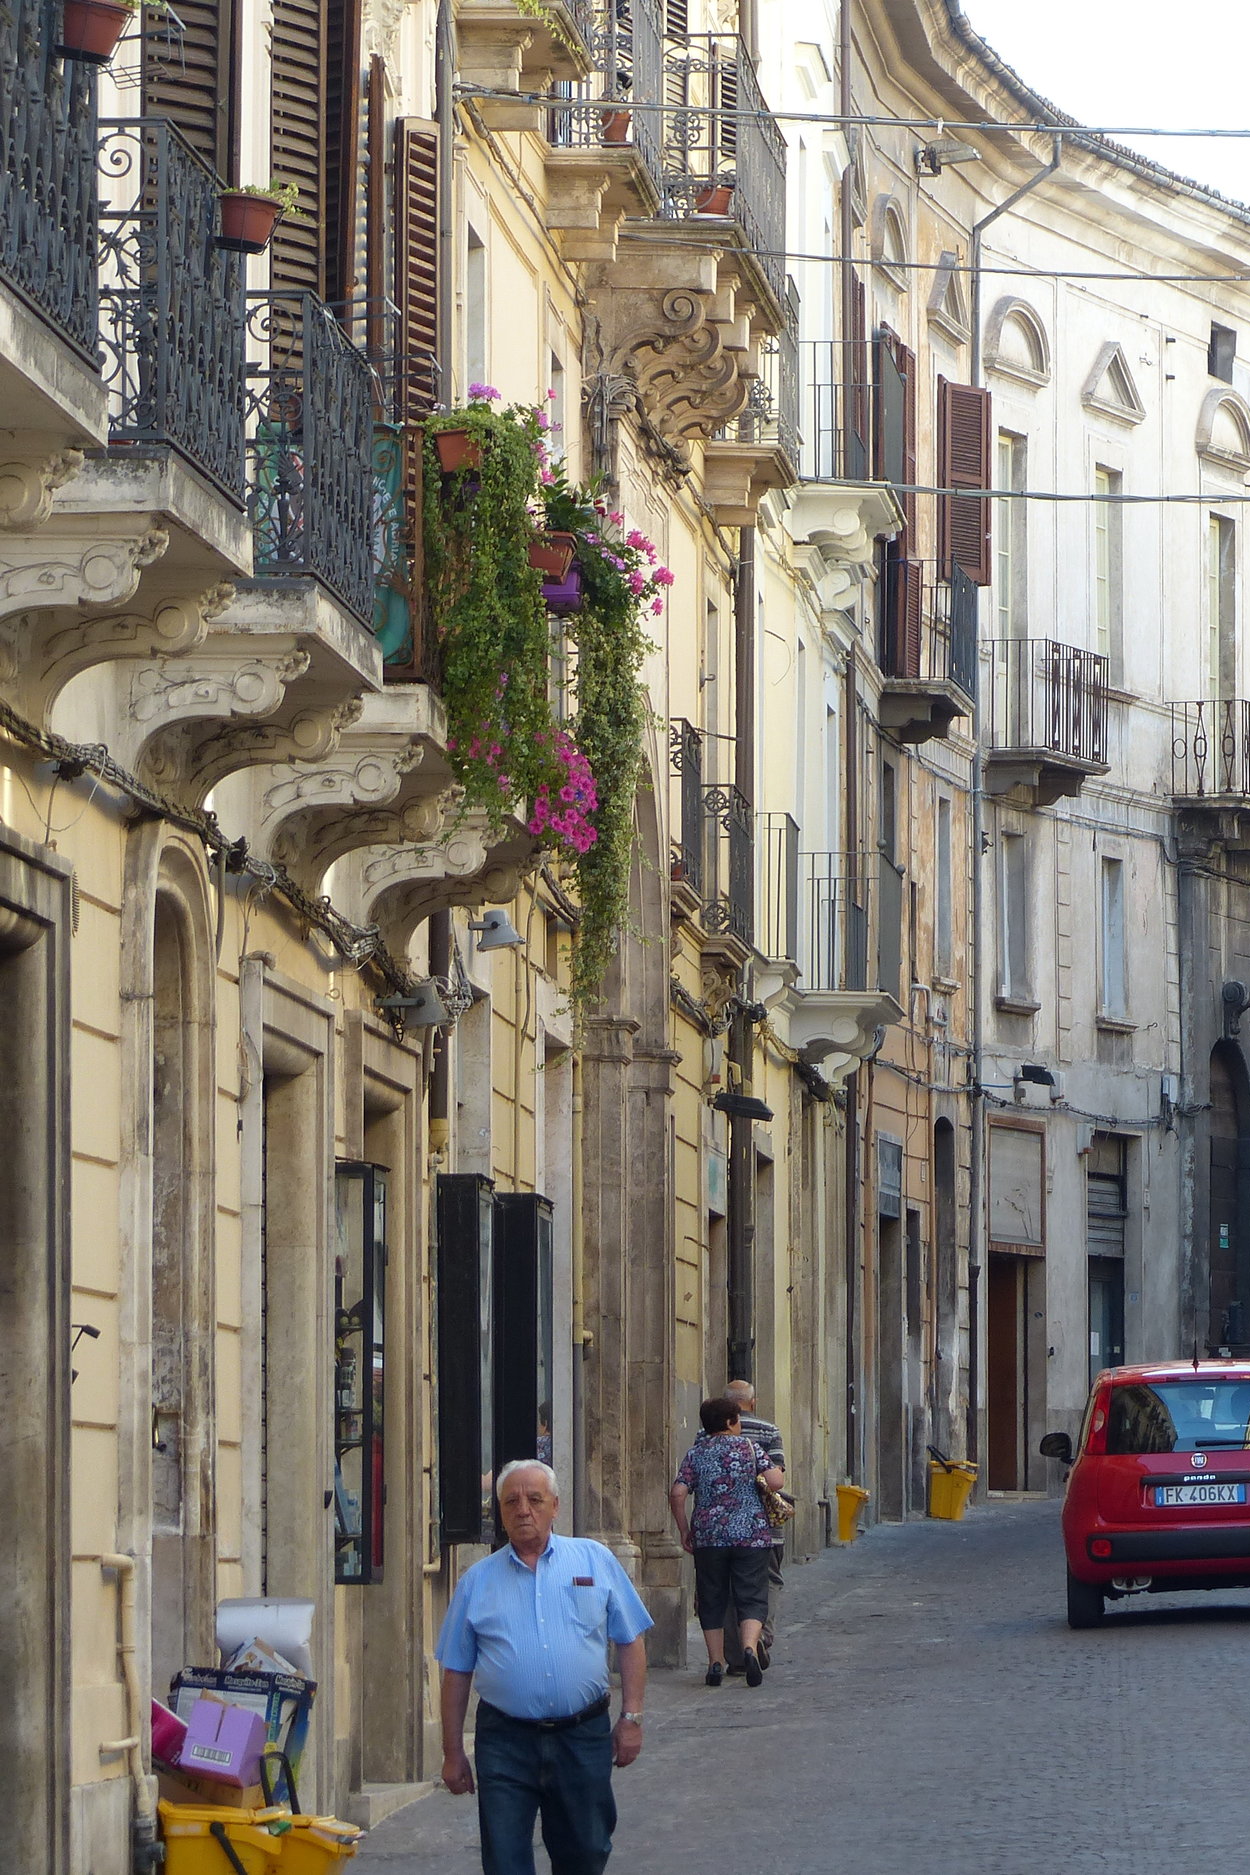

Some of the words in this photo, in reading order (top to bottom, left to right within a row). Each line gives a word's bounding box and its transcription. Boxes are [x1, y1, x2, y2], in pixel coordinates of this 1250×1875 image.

[1183, 1474, 1216, 1482] panda
[1165, 1487, 1184, 1503] FK
[1189, 1485, 1236, 1502] 406KX
